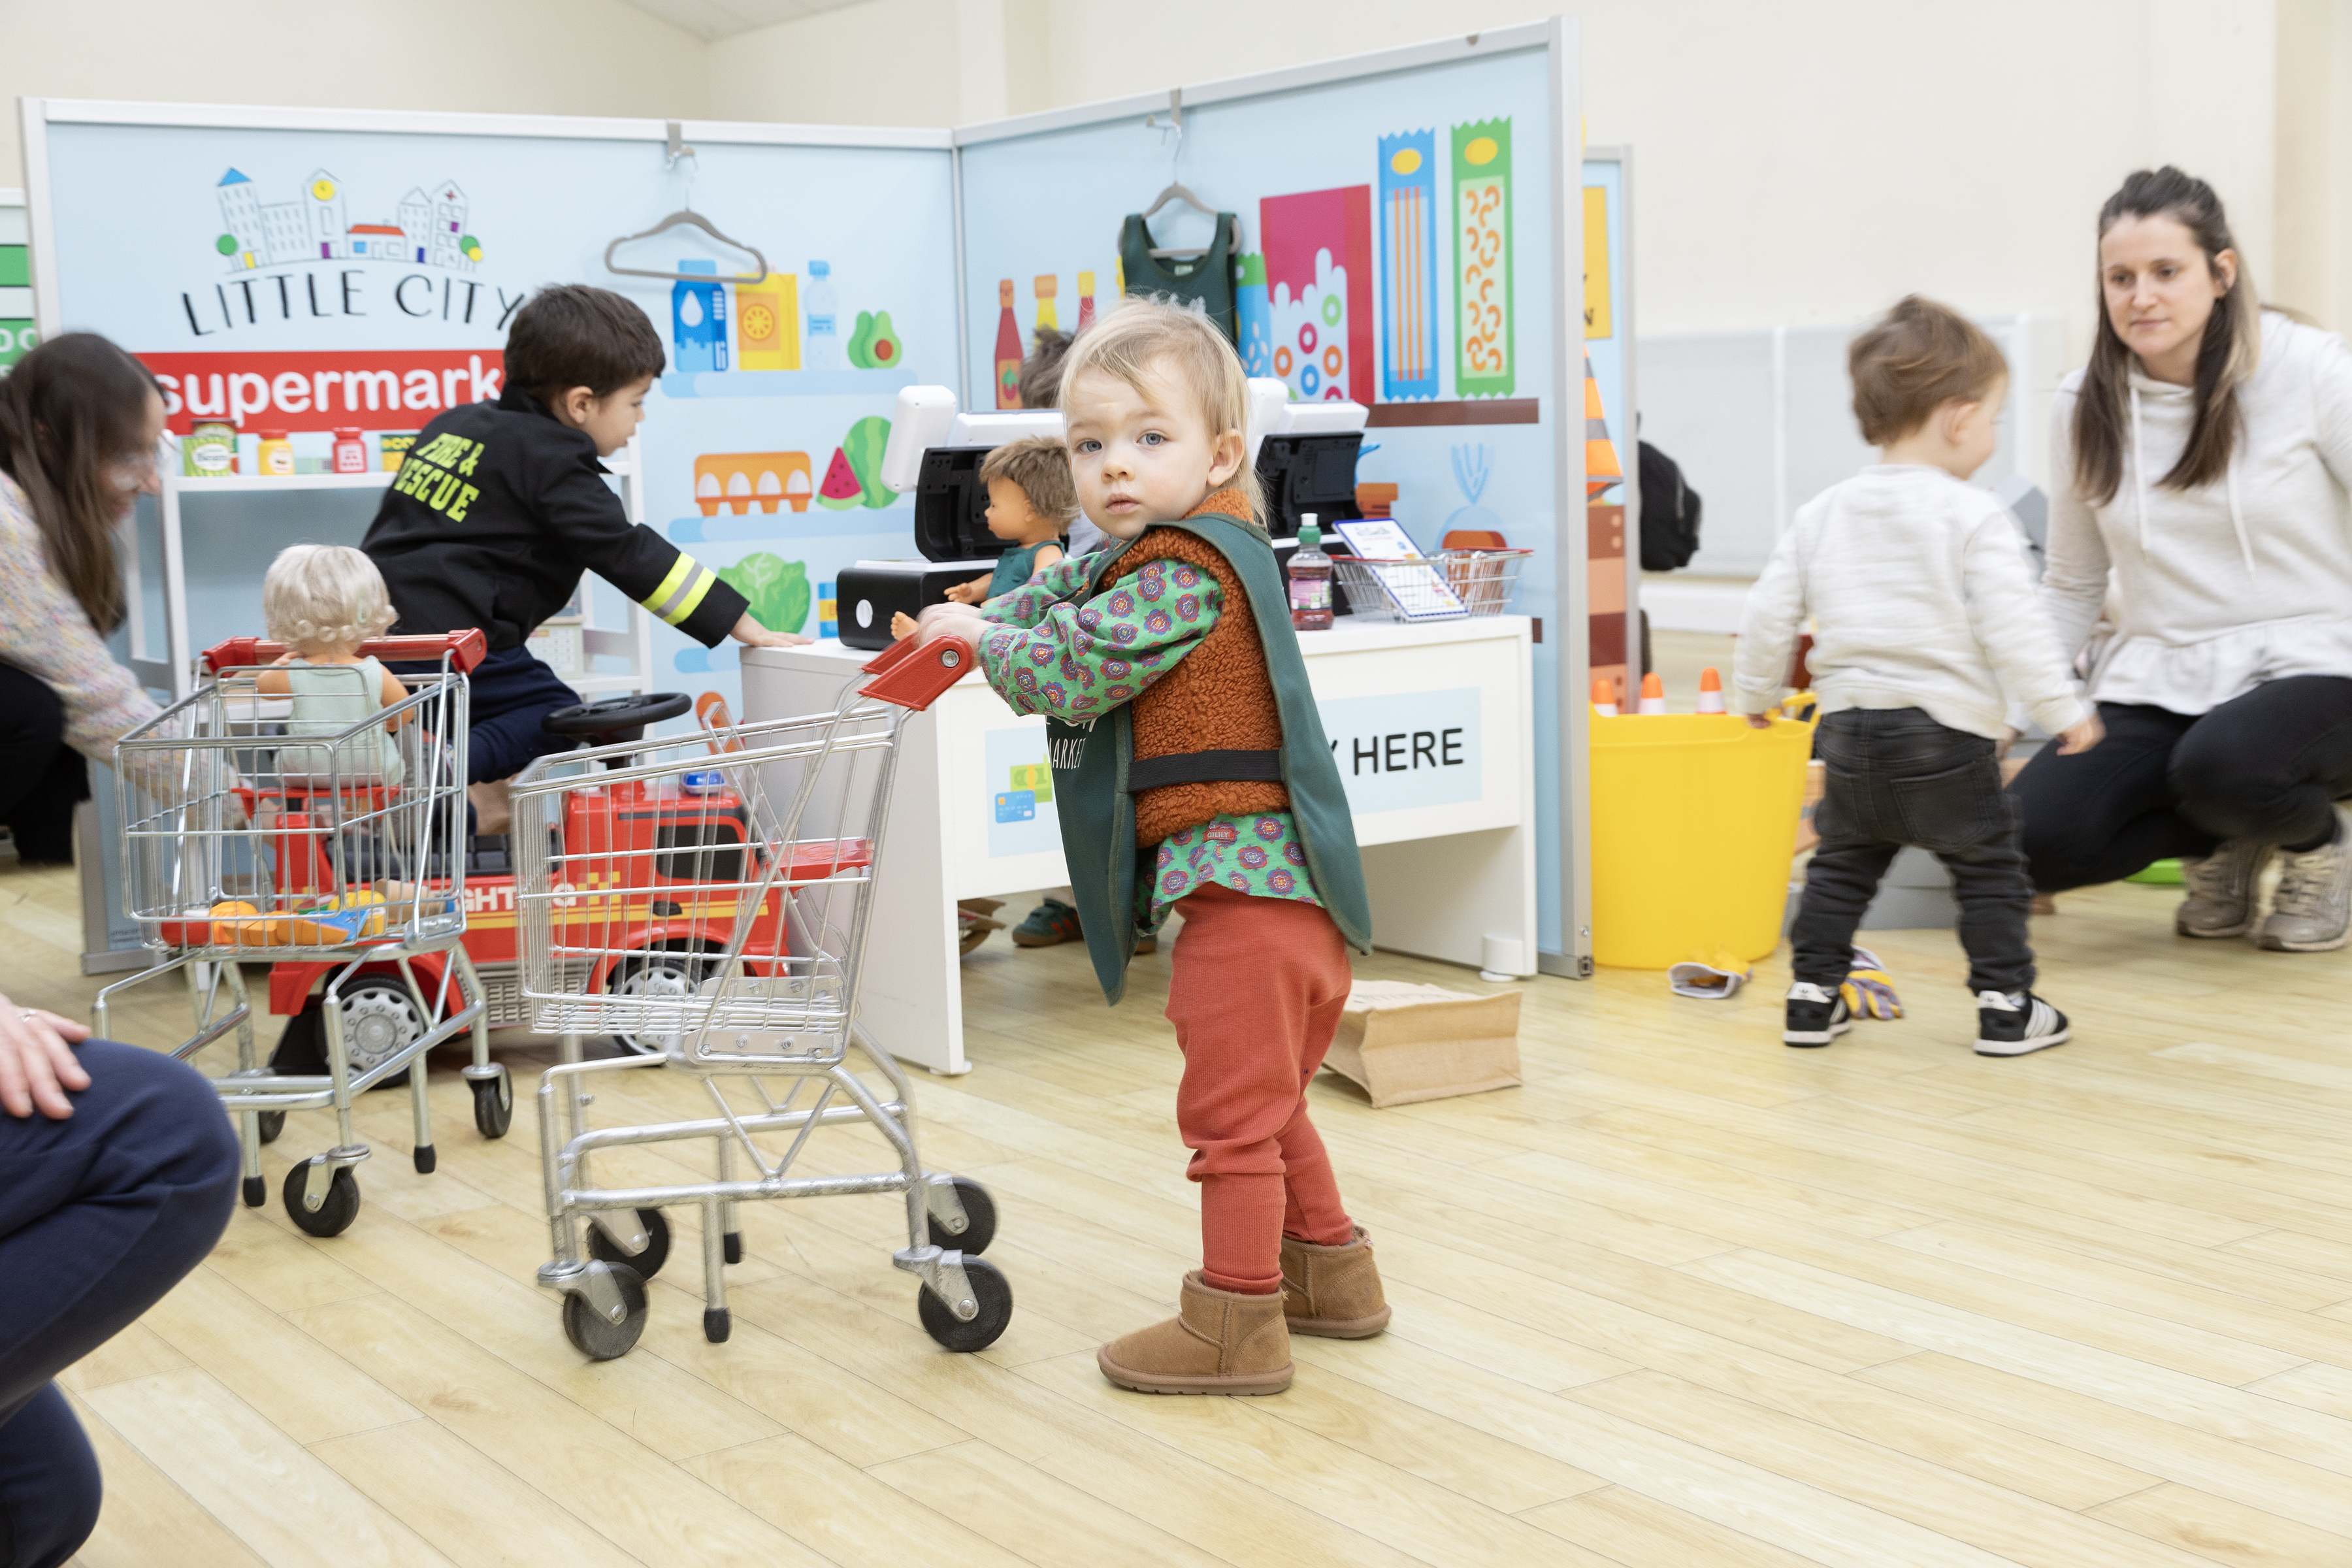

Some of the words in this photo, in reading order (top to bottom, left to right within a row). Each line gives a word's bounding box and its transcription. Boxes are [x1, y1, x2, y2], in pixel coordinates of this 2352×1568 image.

[181, 270, 368, 336] LITTLE
[394, 273, 525, 331] CITY
[154, 354, 502, 428] supermark
[393, 457, 481, 523] ESCUE
[458, 442, 485, 478] &
[1353, 728, 1463, 776] HERE
